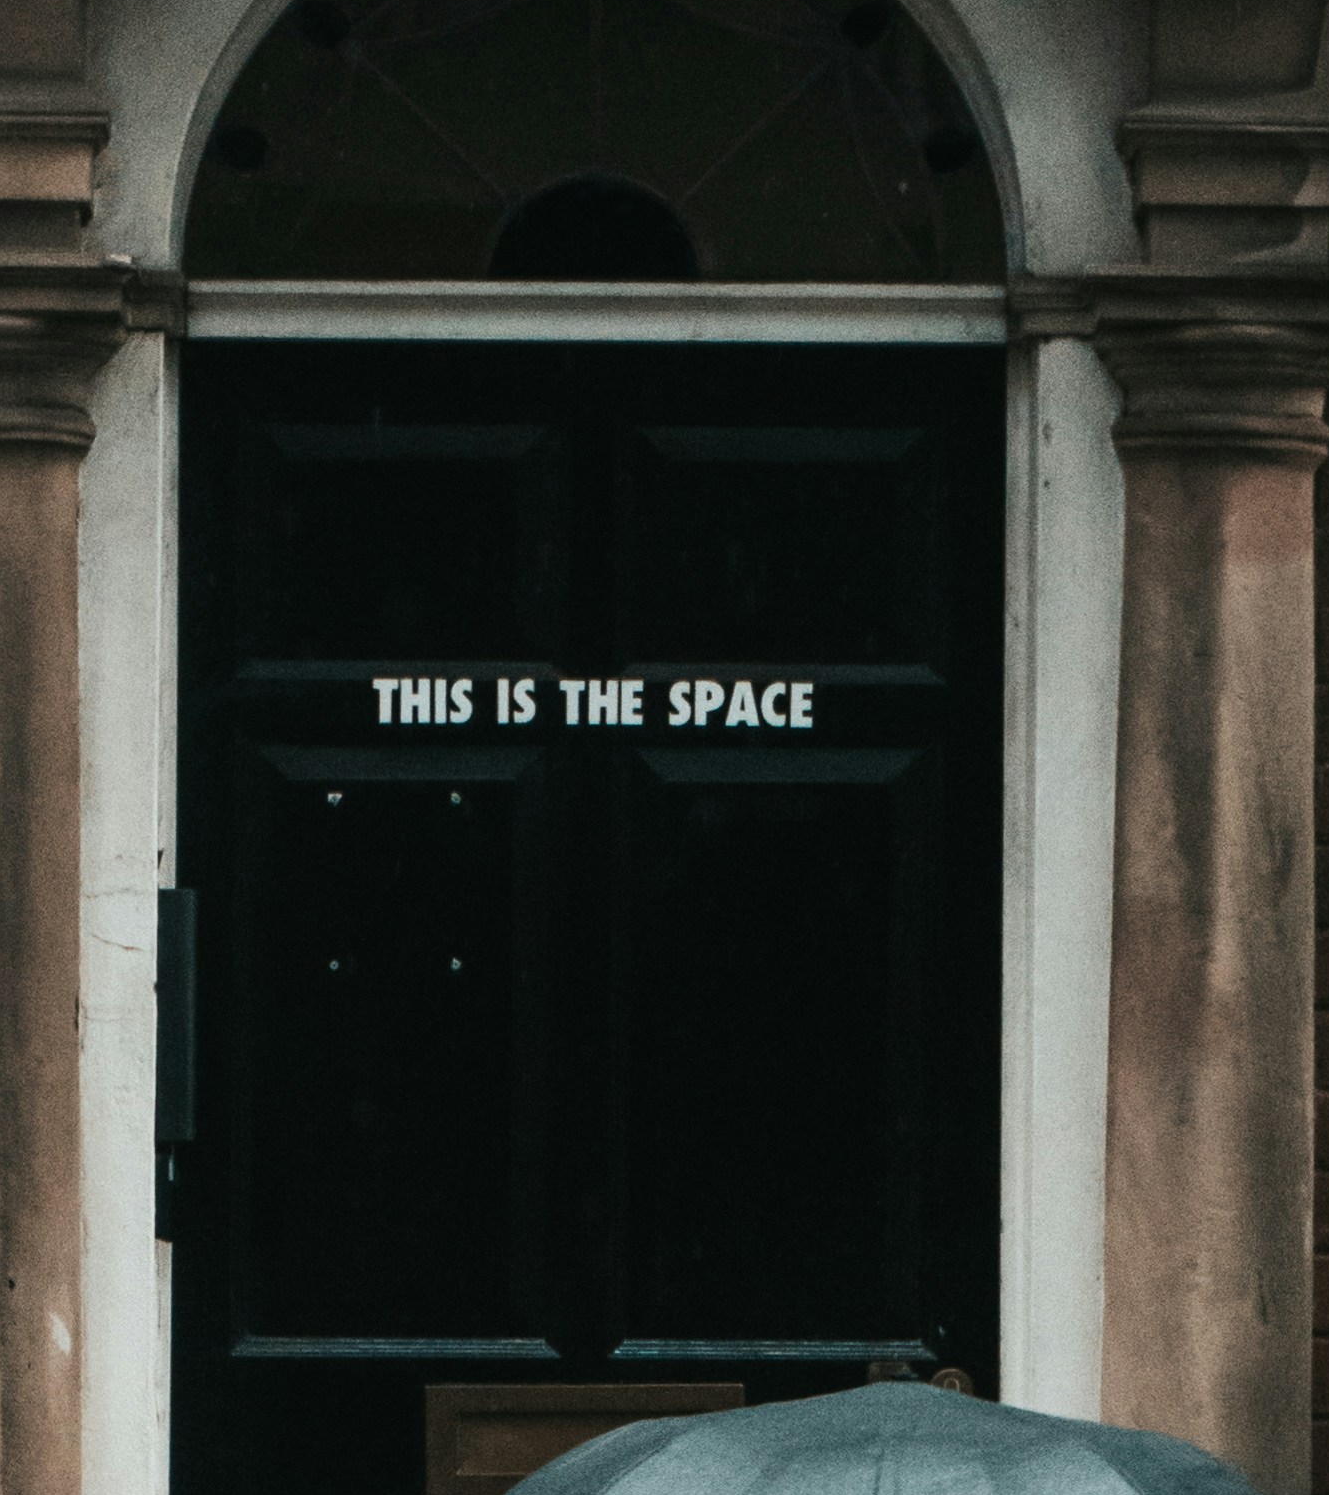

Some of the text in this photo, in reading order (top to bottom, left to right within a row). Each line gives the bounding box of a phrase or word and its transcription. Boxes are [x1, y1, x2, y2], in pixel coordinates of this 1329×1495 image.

[372, 677, 814, 728] THIS IS THE SPACE
